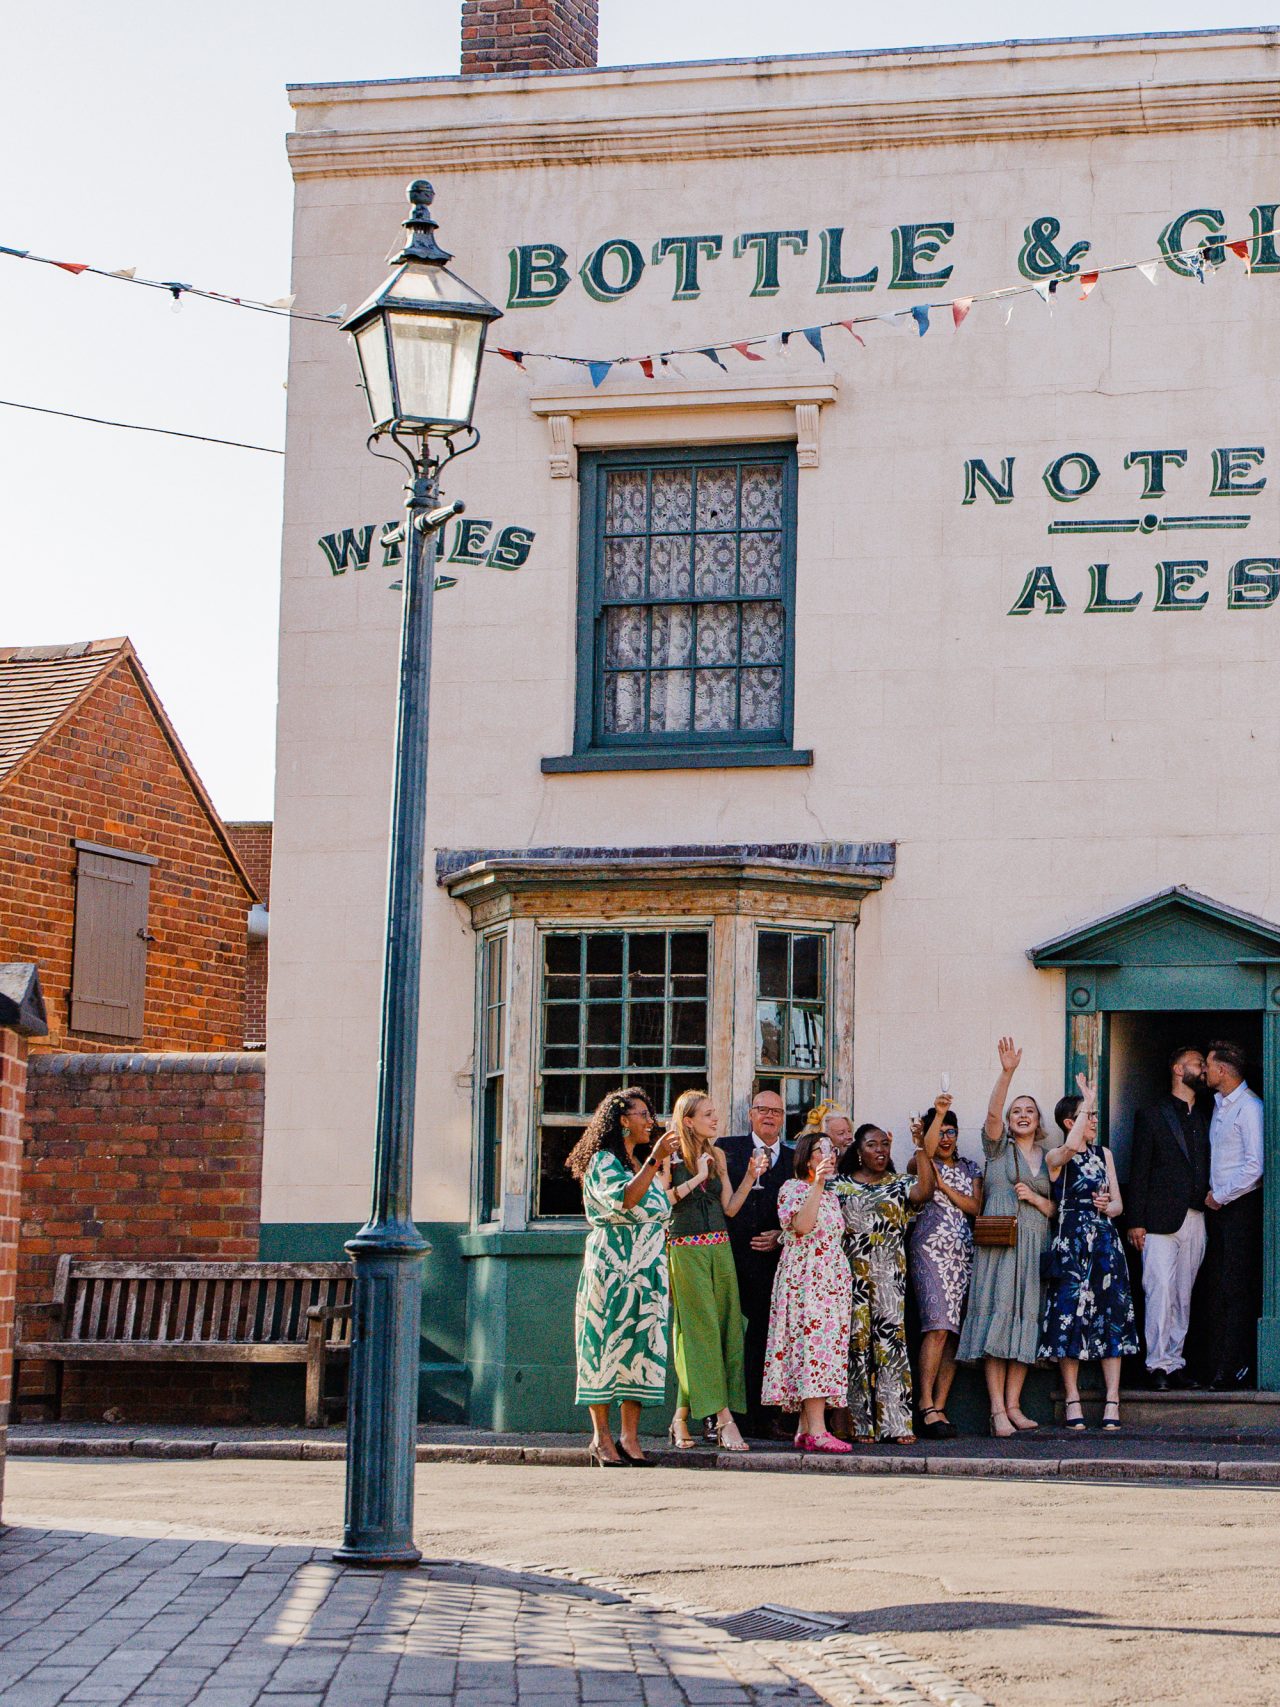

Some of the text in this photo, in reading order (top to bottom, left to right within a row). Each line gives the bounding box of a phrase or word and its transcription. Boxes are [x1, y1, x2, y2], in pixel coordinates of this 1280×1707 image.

[506, 222, 955, 309] BOTTLE
[1017, 217, 1092, 282] &
[318, 519, 537, 577] WIES
